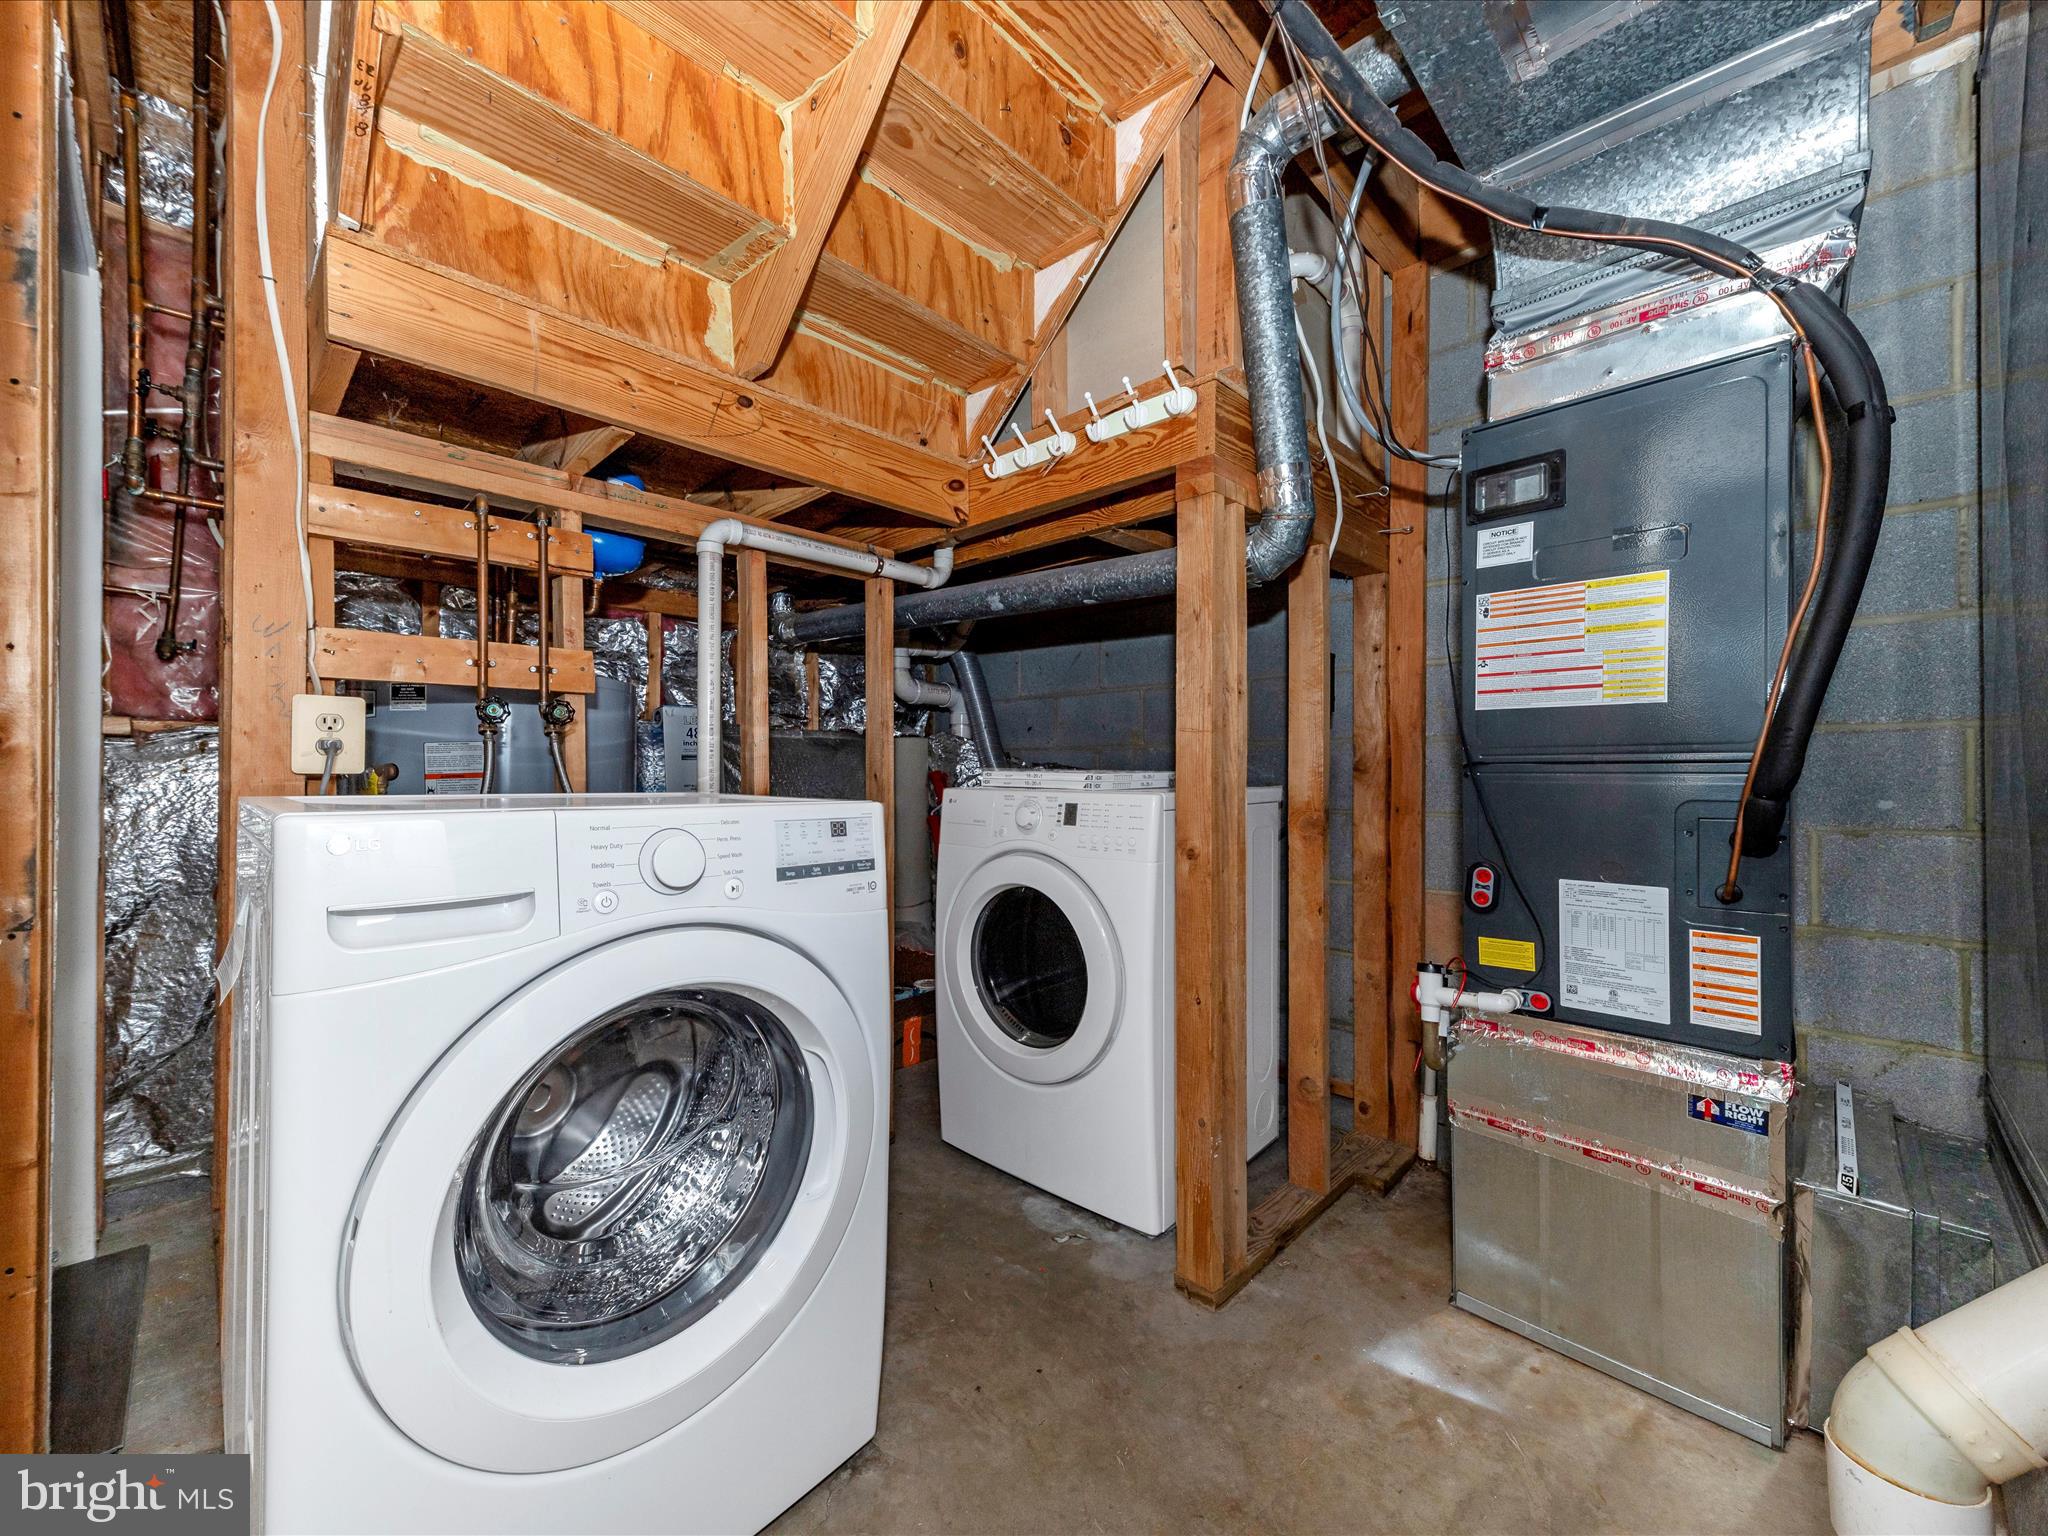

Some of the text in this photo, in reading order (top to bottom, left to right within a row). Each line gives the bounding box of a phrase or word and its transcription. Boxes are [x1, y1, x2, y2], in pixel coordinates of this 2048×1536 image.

[1718, 280, 1751, 296] AF 100
[1648, 300, 1689, 318] Shurtape
[1610, 321, 1622, 330] 100
[1626, 316, 1637, 325] AF
[1612, 1049, 1626, 1058] 100
[1725, 1102, 1764, 1118] FLOW
[1725, 1110, 1765, 1126] RIGHT
[1553, 1139, 1567, 1147] 100
[1570, 1143, 1581, 1151] AF
[1591, 1150, 1632, 1168] Shurtape
[1660, 1172, 1675, 1182] 100
[1701, 1184, 1752, 1206] Shurtape
